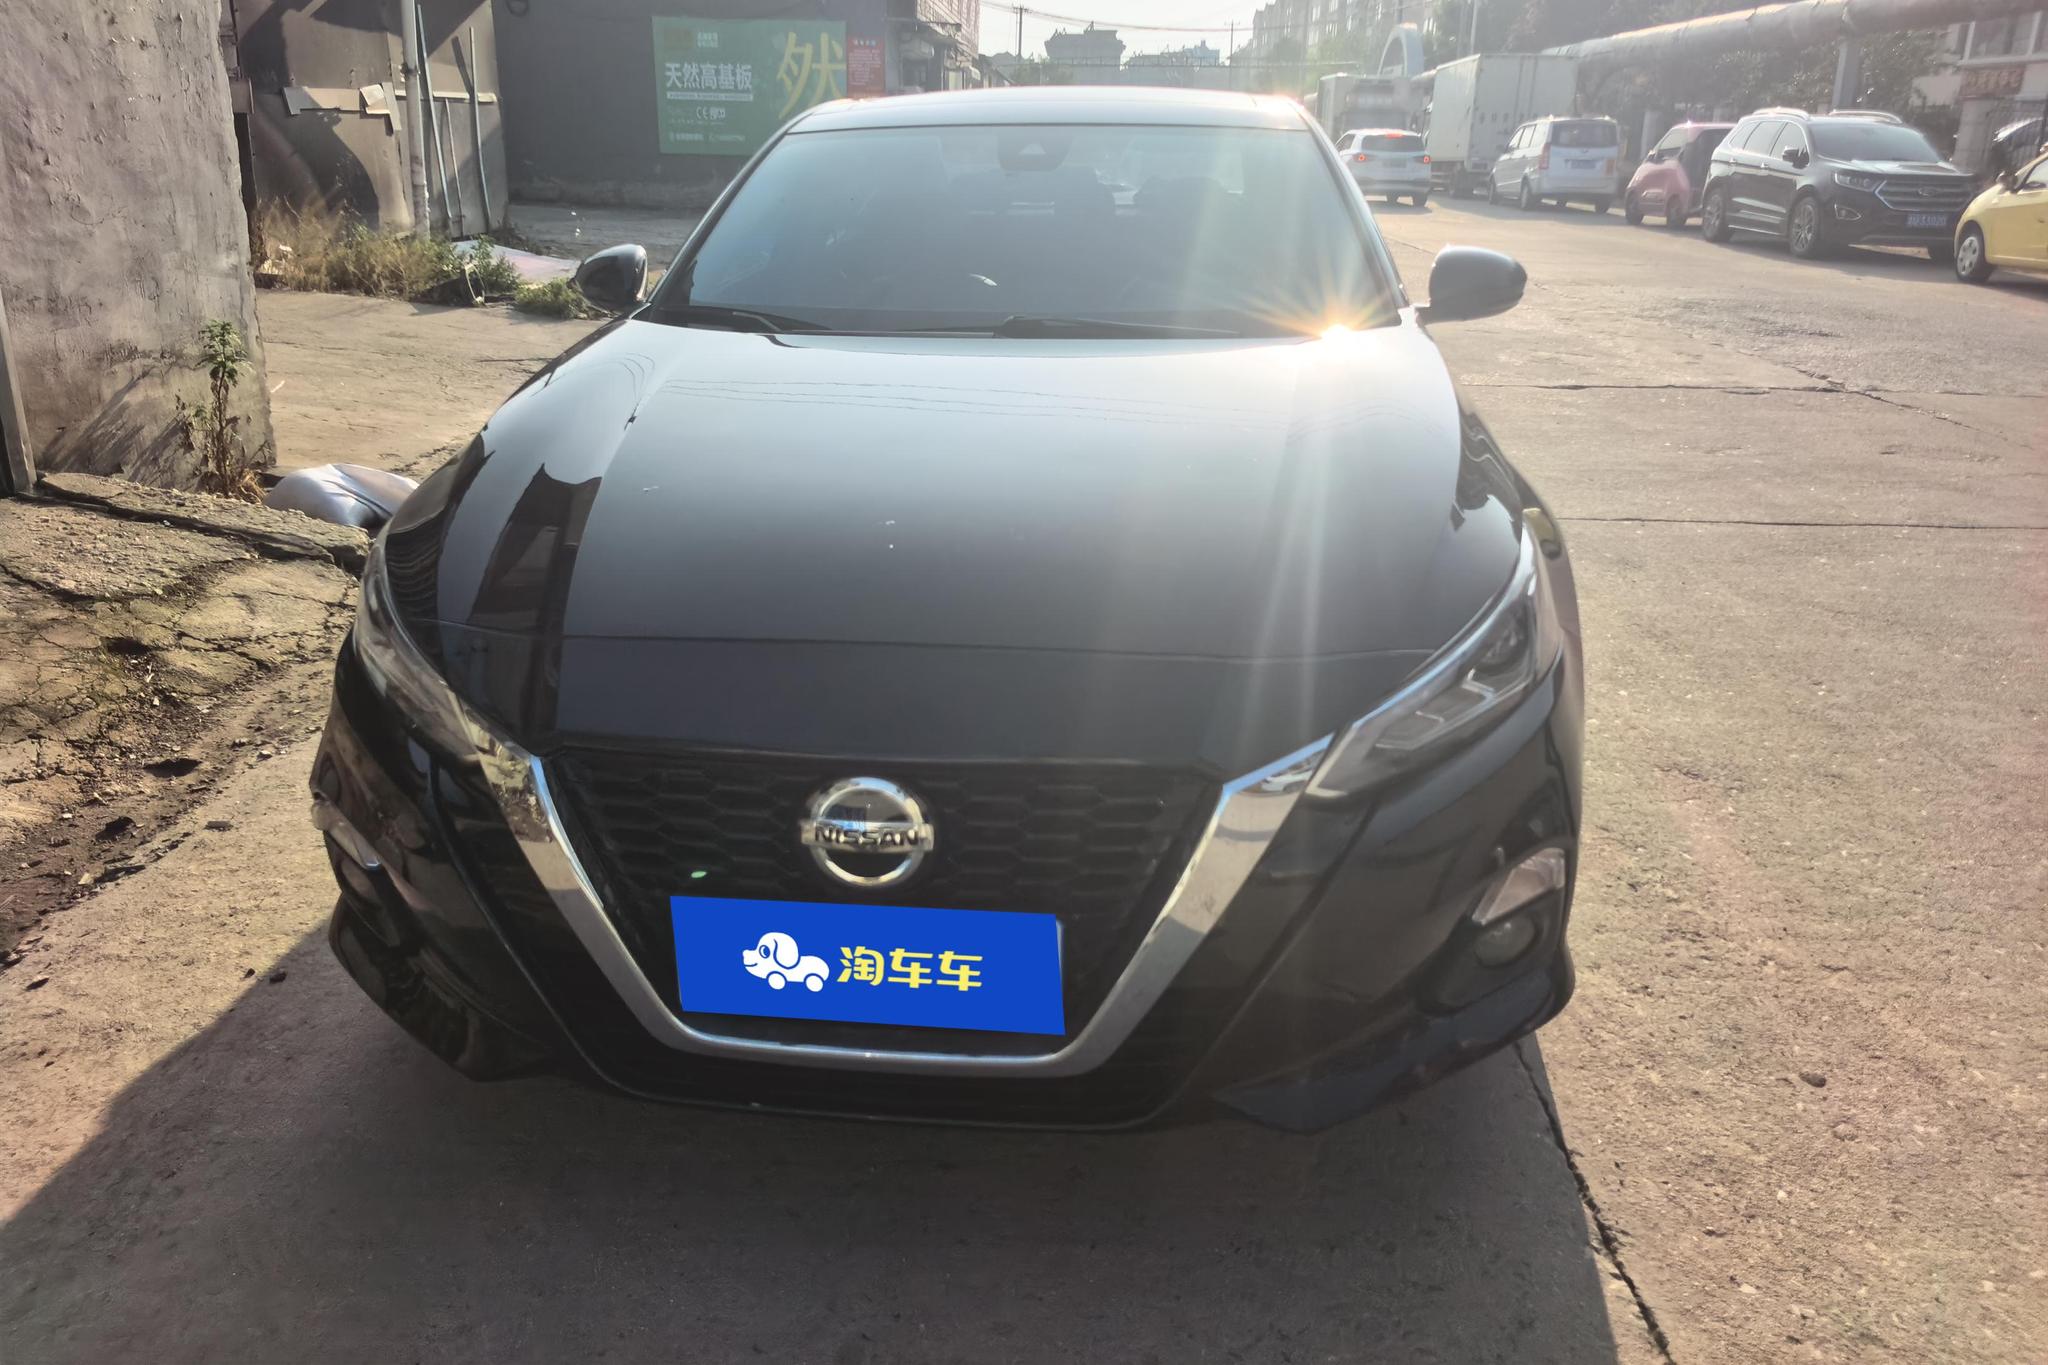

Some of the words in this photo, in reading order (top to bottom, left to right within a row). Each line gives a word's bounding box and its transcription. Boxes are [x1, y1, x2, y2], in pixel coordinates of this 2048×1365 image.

[663, 62, 753, 90] 天然高基板
[814, 826, 919, 846] NISSAN
